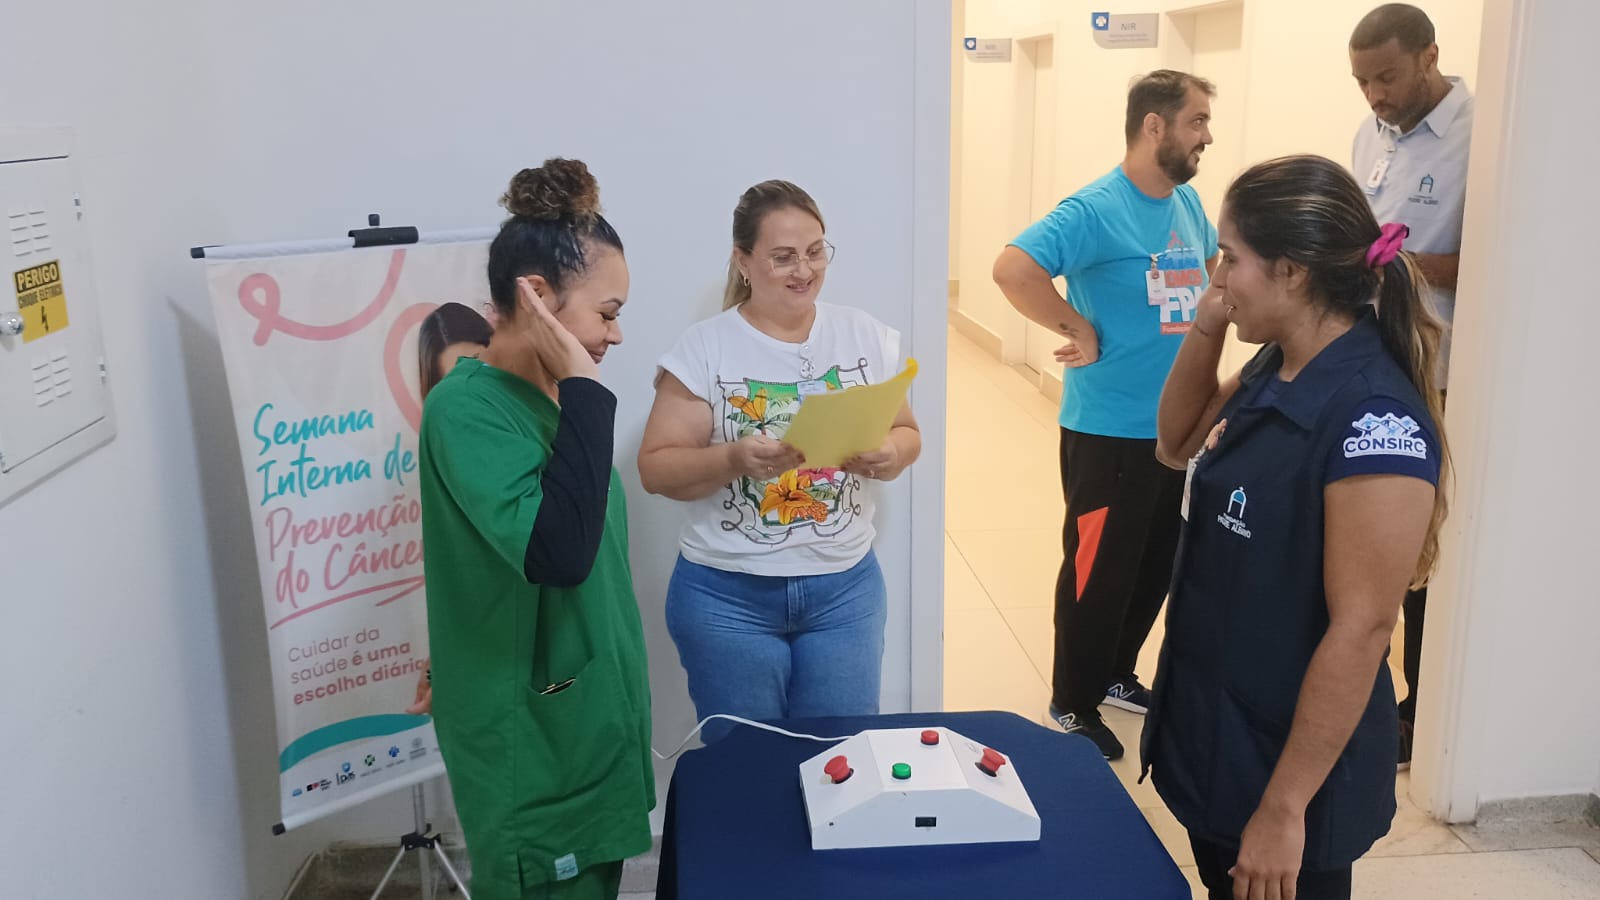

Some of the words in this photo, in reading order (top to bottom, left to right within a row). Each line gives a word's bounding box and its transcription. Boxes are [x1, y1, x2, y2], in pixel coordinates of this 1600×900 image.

[17, 263, 58, 291] PERIGO
[253, 403, 374, 456] Semana
[1344, 437, 1424, 453] CONSIRC
[256, 443, 372, 506] Interna
[384, 432, 417, 486] de
[265, 494, 421, 562] Prevenção
[276, 550, 310, 609] do
[288, 635, 350, 662] Cuidar
[355, 628, 380, 644] da
[290, 657, 347, 684] saúde
[352, 650, 363, 666] é
[367, 642, 411, 662] uma
[293, 674, 367, 705] escolha
